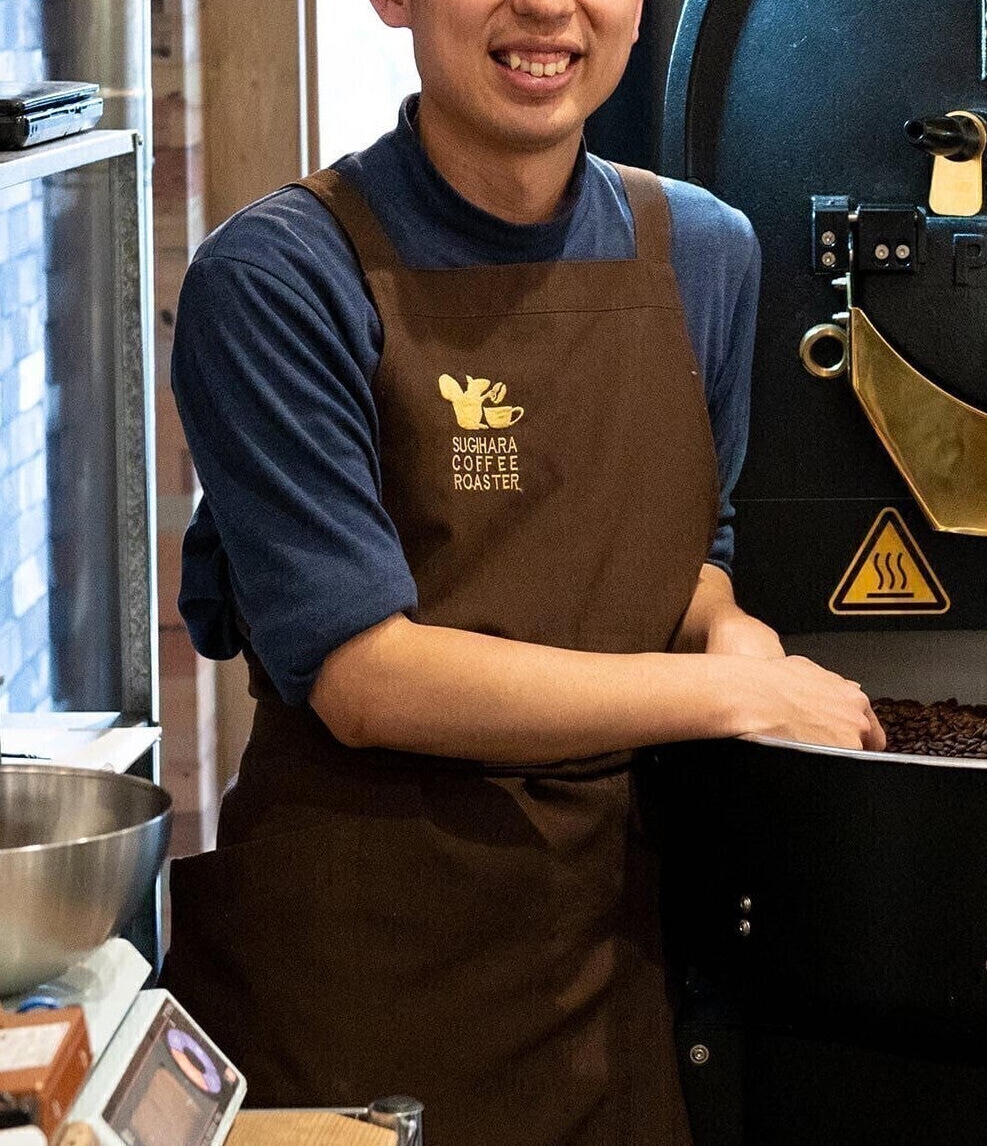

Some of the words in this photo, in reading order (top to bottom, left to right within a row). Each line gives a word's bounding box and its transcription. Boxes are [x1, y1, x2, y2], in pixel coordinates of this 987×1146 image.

[452, 436, 518, 453] SUGIHARA
[452, 454, 519, 471] COFFEE
[454, 473, 521, 490] ROASTER
